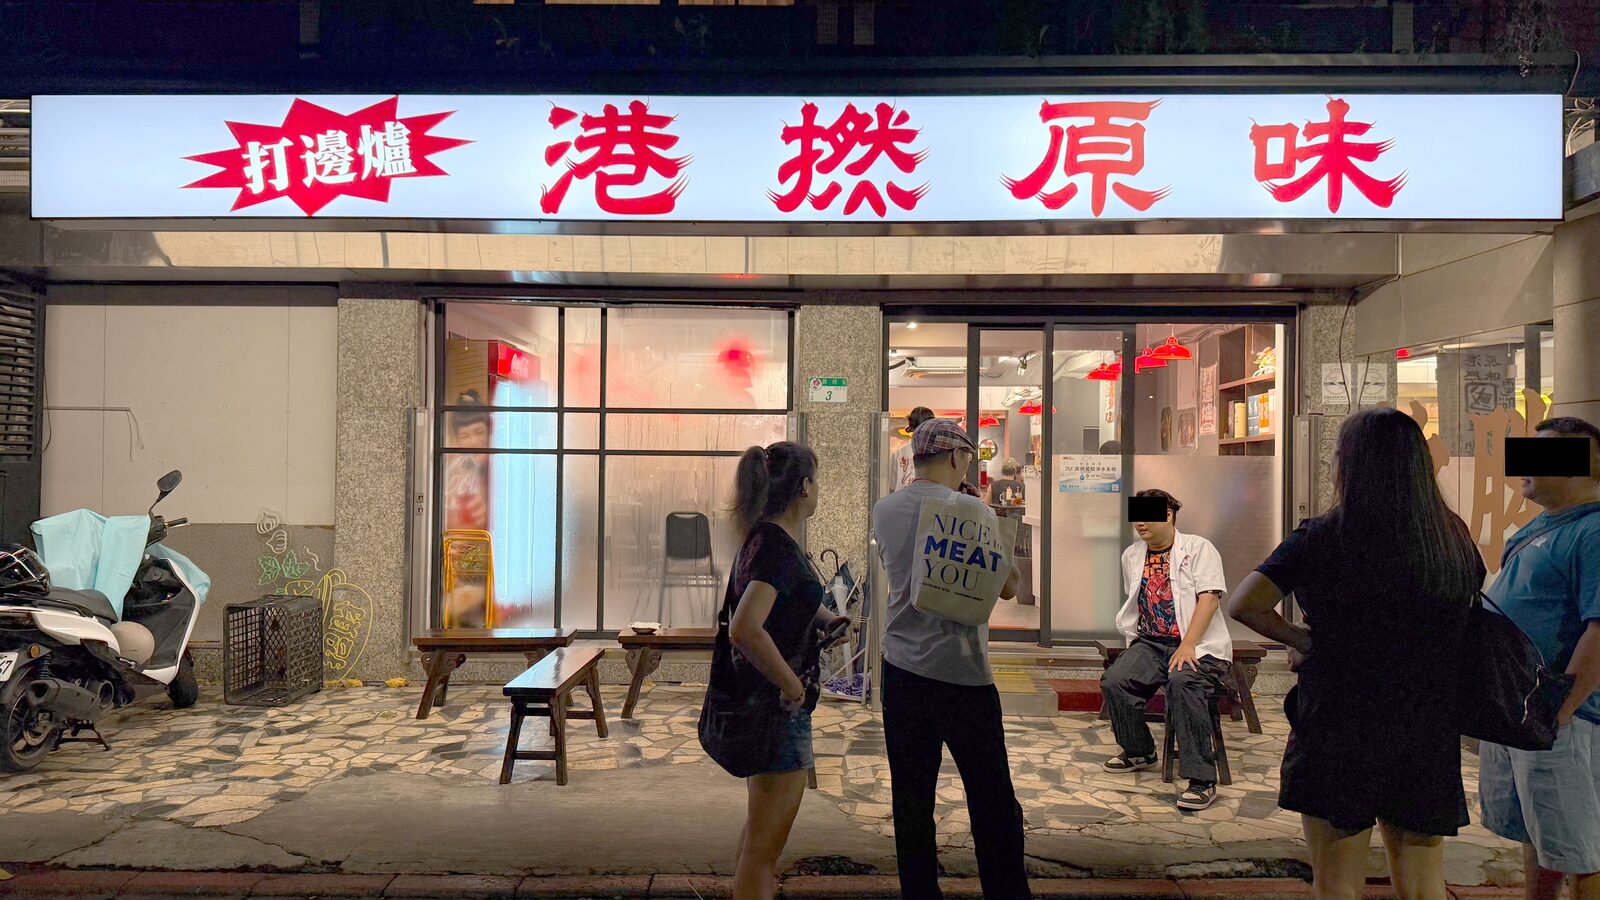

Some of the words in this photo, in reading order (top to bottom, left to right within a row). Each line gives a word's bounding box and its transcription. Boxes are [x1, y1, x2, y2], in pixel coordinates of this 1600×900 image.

[241, 119, 416, 195] 打邊爐
[540, 97, 1408, 217] 港撚原味
[825, 390, 833, 401] 3
[929, 514, 991, 545] NICE
[924, 535, 1002, 573] MEAT
[923, 558, 982, 591] YOU
